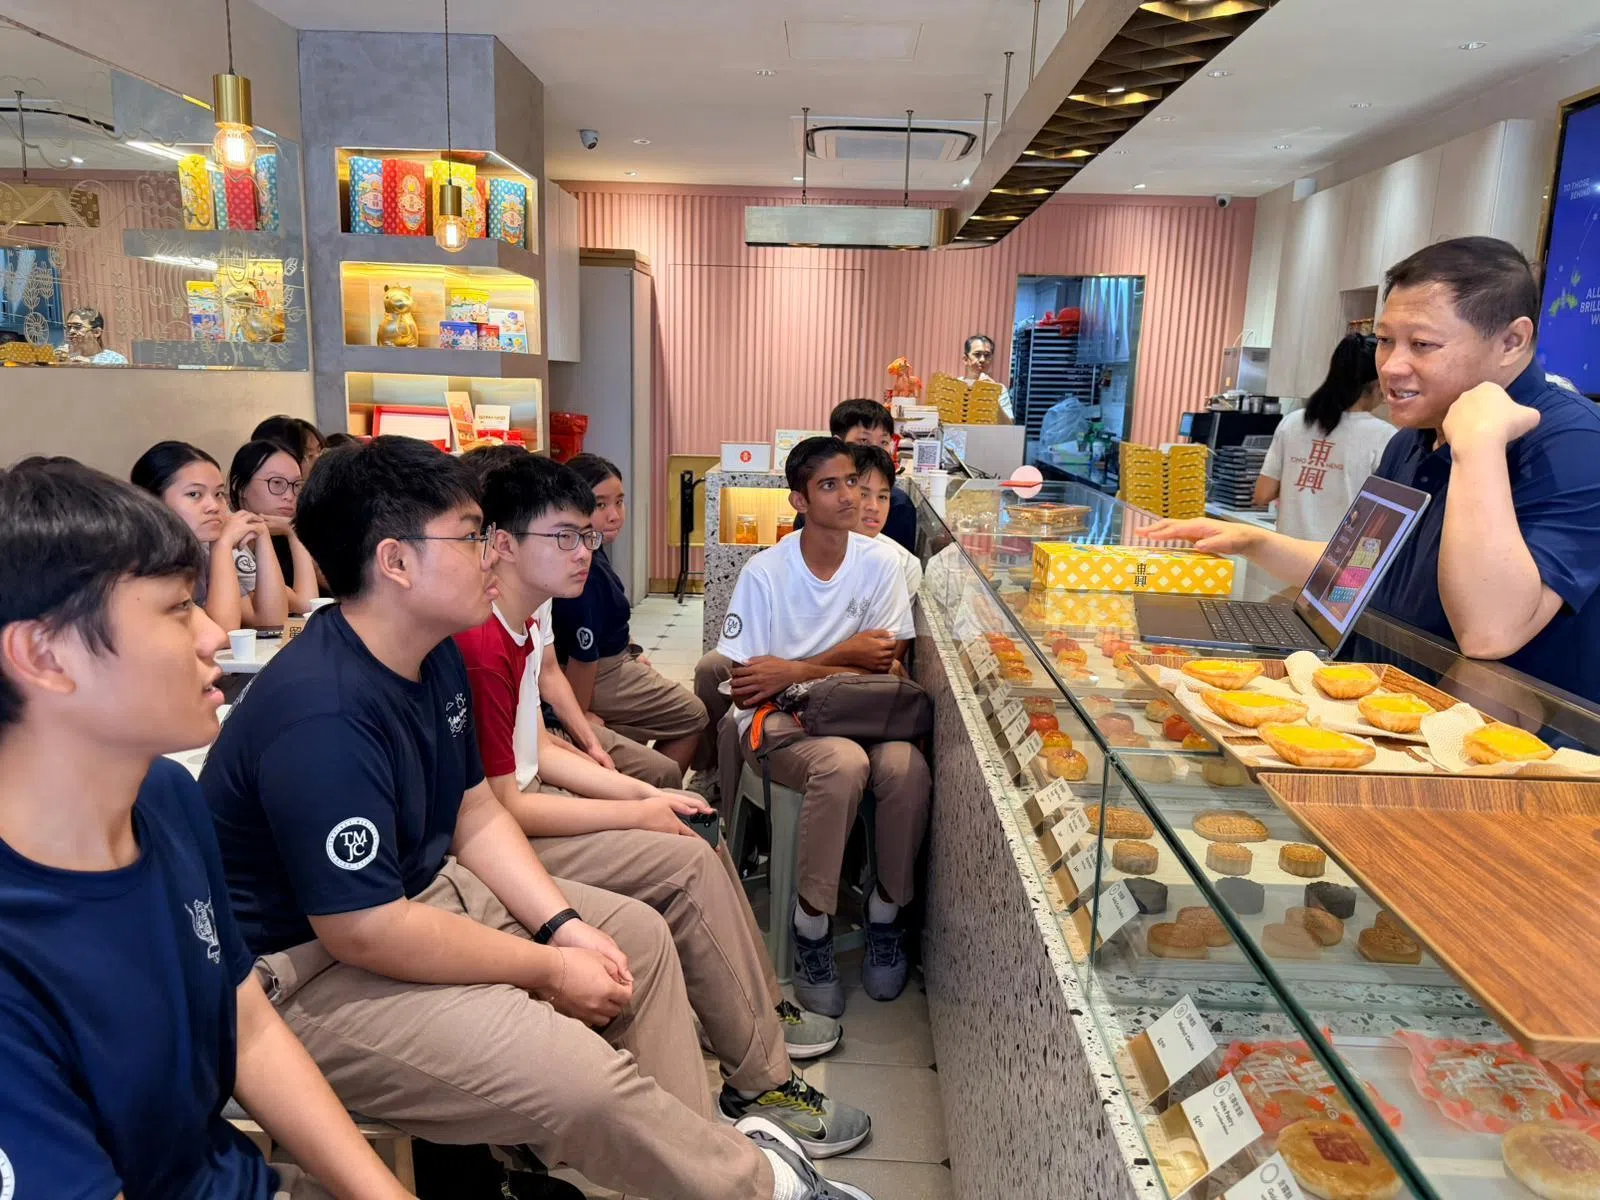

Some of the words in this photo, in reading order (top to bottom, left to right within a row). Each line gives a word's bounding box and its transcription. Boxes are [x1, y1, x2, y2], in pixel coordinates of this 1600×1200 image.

[1570, 186, 1591, 201] BEHIND
[339, 829, 368, 847] TM
[346, 842, 366, 862] JC
[1222, 1110, 1236, 1127] Pastry
